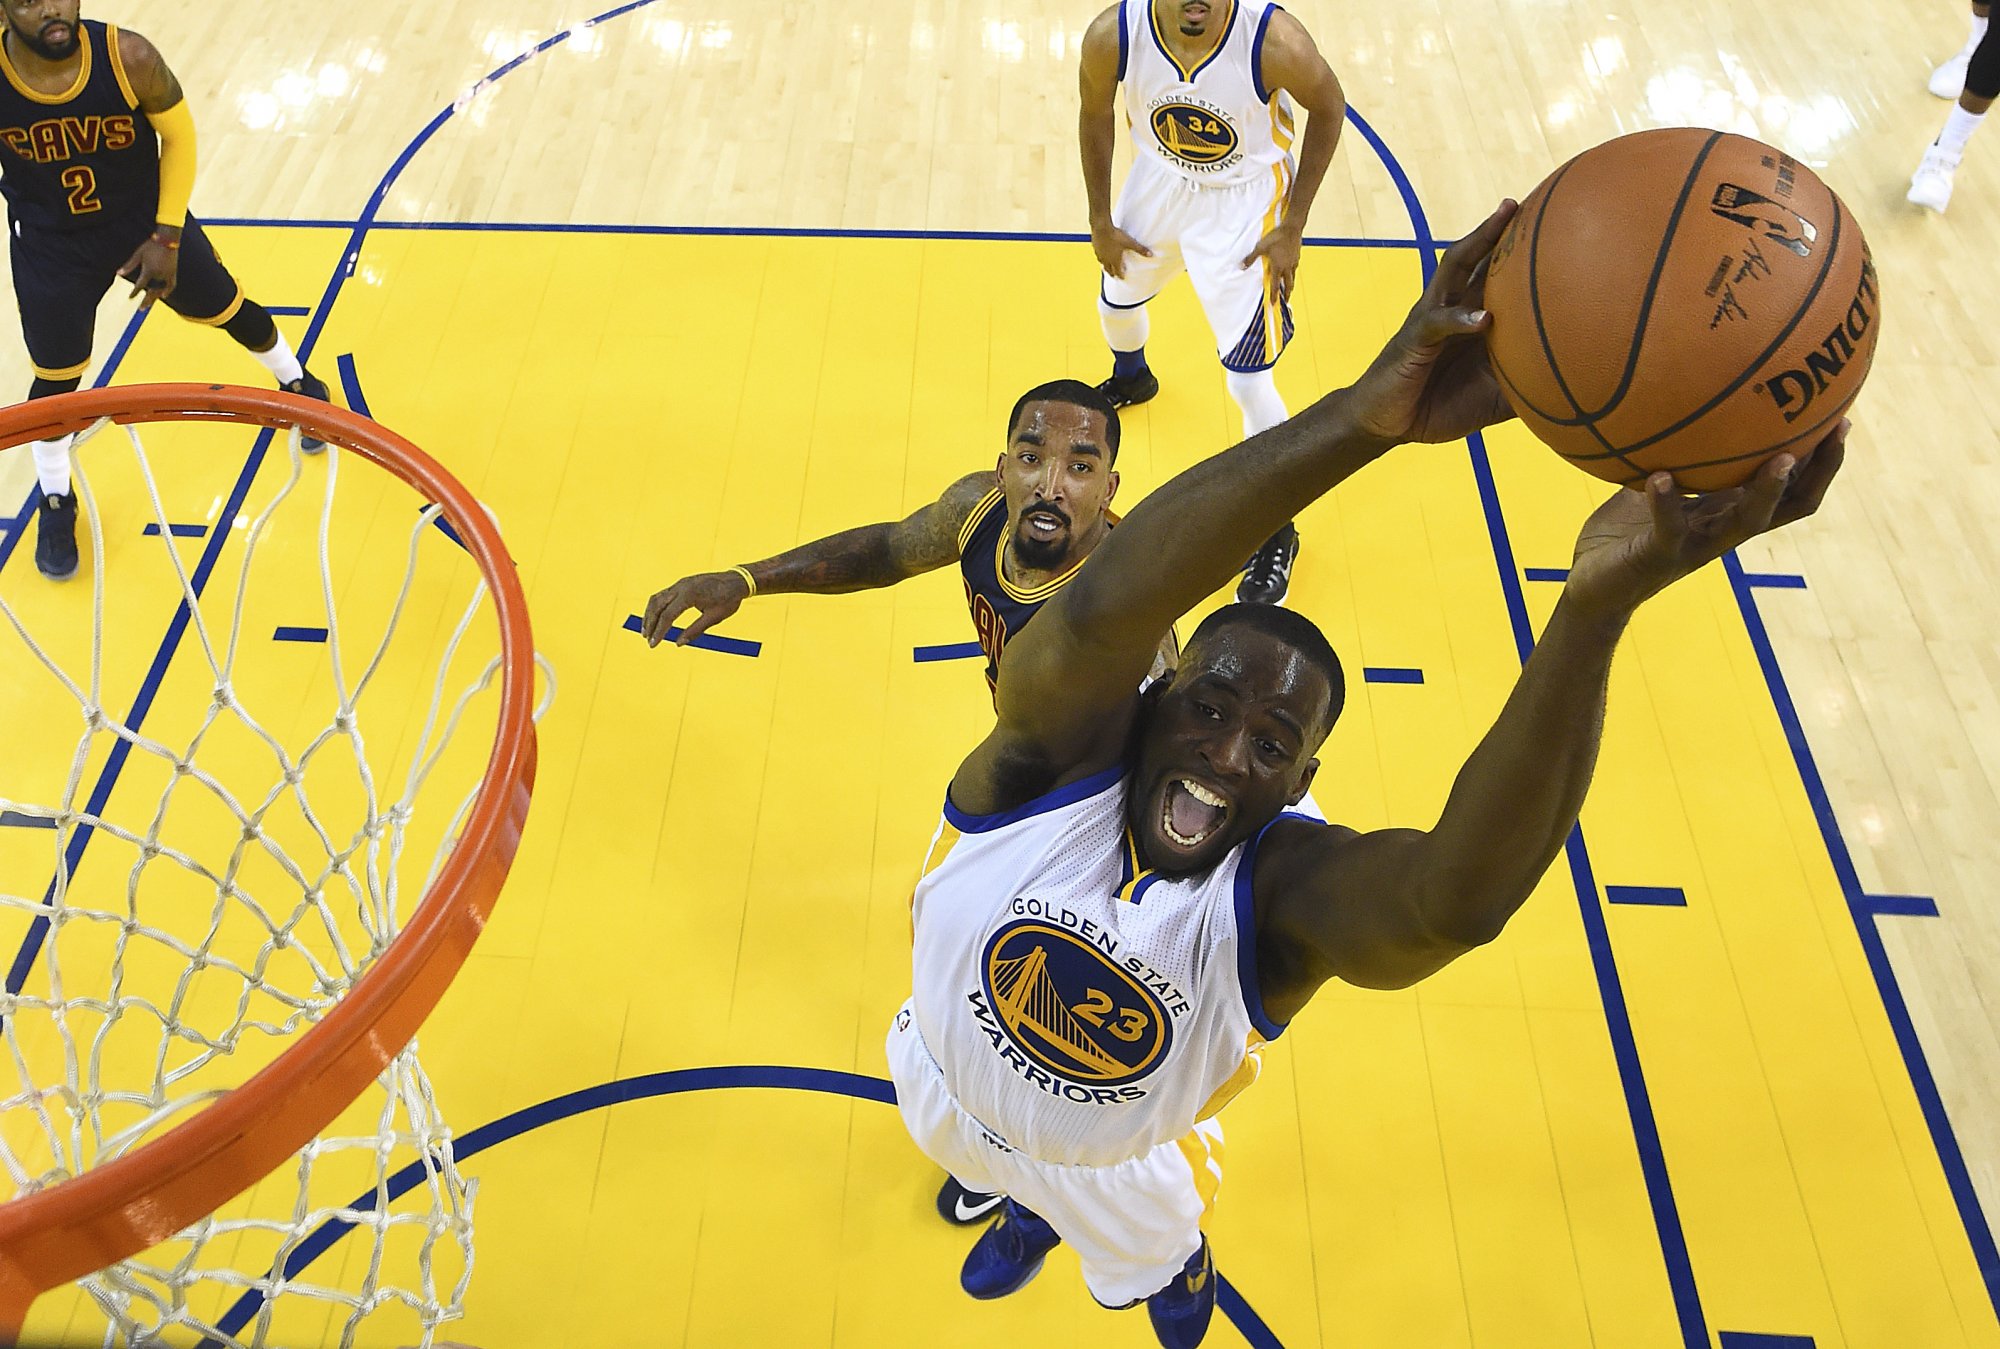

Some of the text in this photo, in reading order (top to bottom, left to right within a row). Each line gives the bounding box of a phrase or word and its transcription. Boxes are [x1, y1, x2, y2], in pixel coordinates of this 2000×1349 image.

[1146, 95, 1236, 123] GOLDEN STATE
[1188, 115, 1221, 136] 34
[0, 115, 136, 163] CAVS
[1157, 145, 1244, 173] WARRIORS
[61, 165, 102, 215] 2
[1012, 897, 1191, 1018] GOLDEN STATE
[1071, 987, 1149, 1043] 23
[967, 989, 1148, 1106] WARRIORS
